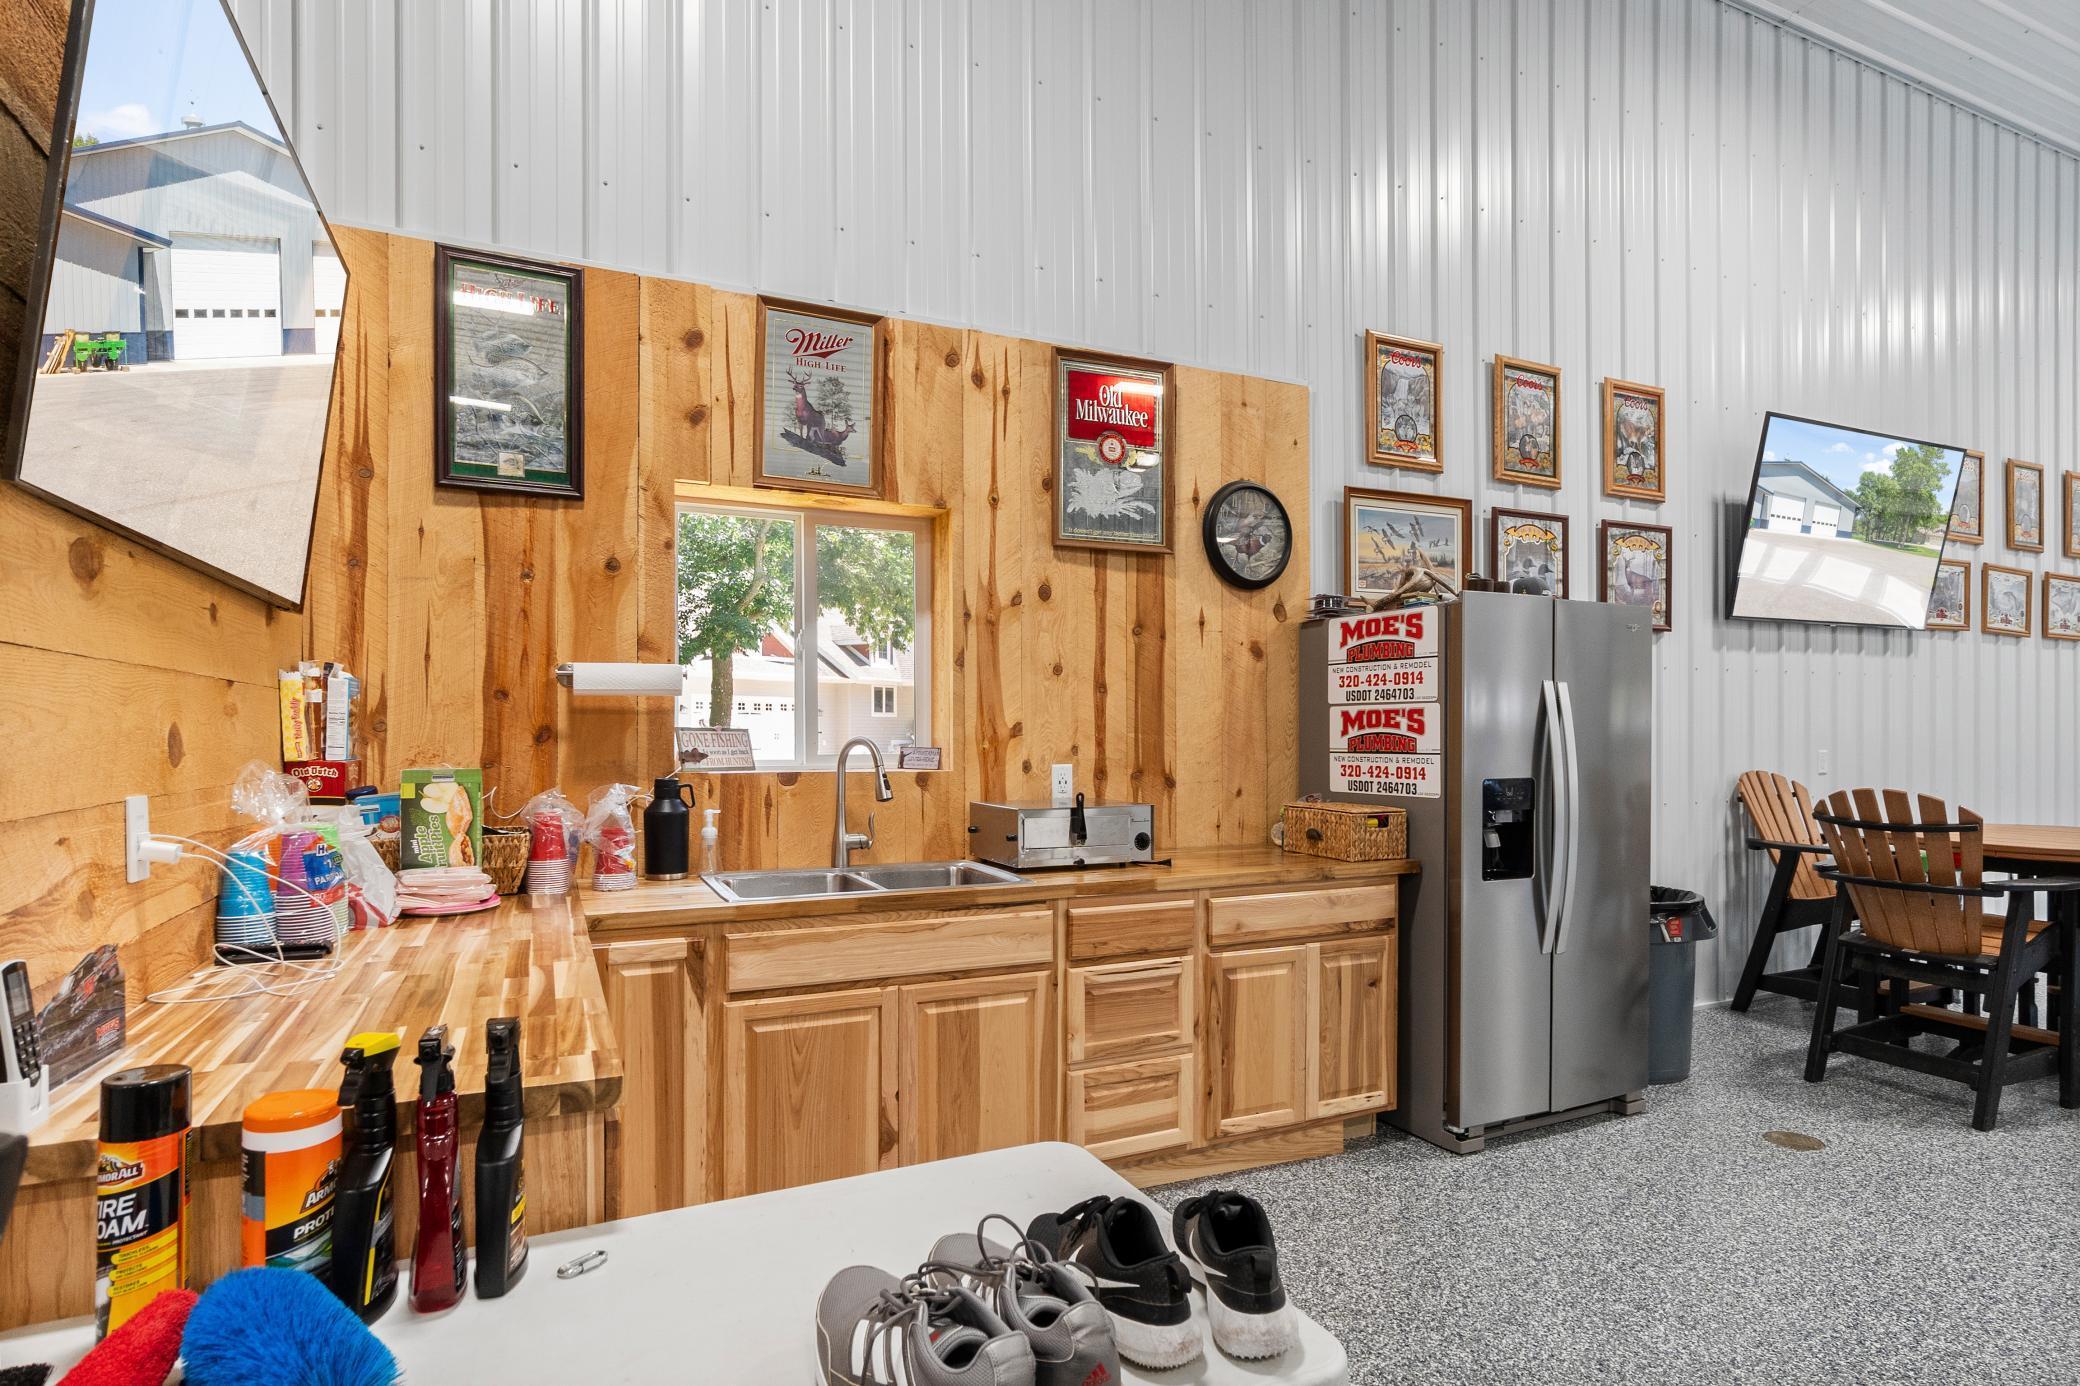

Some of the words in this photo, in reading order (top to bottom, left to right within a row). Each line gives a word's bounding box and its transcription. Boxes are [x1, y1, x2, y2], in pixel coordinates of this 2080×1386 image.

[784, 328, 854, 355] Miller
[796, 357, 821, 369] HIGH
[825, 361, 847, 373] LIFE
[1390, 350, 1423, 369] Coors
[1099, 384, 1123, 408] Old
[1075, 398, 1149, 428] Milwaukee
[1340, 612, 1423, 648] MOE'S
[1348, 641, 1414, 663] PLUMBING
[1345, 664, 1391, 673] CONSTRUCTION
[1400, 661, 1432, 669] REMODEL
[1339, 671, 1424, 688] 320-424-0914
[1346, 689, 1373, 702] USDOT
[1374, 688, 1415, 701] 2464703
[1340, 707, 1425, 737] MOE'S
[681, 732, 710, 748] GONE
[710, 732, 749, 748] FISHING
[1349, 734, 1416, 752] PLUMBING
[725, 756, 752, 767] HUNTING
[1347, 756, 1394, 764] CONSTRUCTION
[1402, 757, 1435, 765] REMODEL
[292, 767, 310, 777] Old
[311, 765, 339, 778] Dutch
[1340, 765, 1426, 780] 320-424-0914
[1347, 780, 1374, 793] USDOT
[1376, 781, 1417, 795] 2464703
[415, 825, 433, 863] Apple
[97, 1192, 137, 1219] IRE
[97, 1209, 147, 1240] OAM
[293, 1205, 335, 1240] PROT
